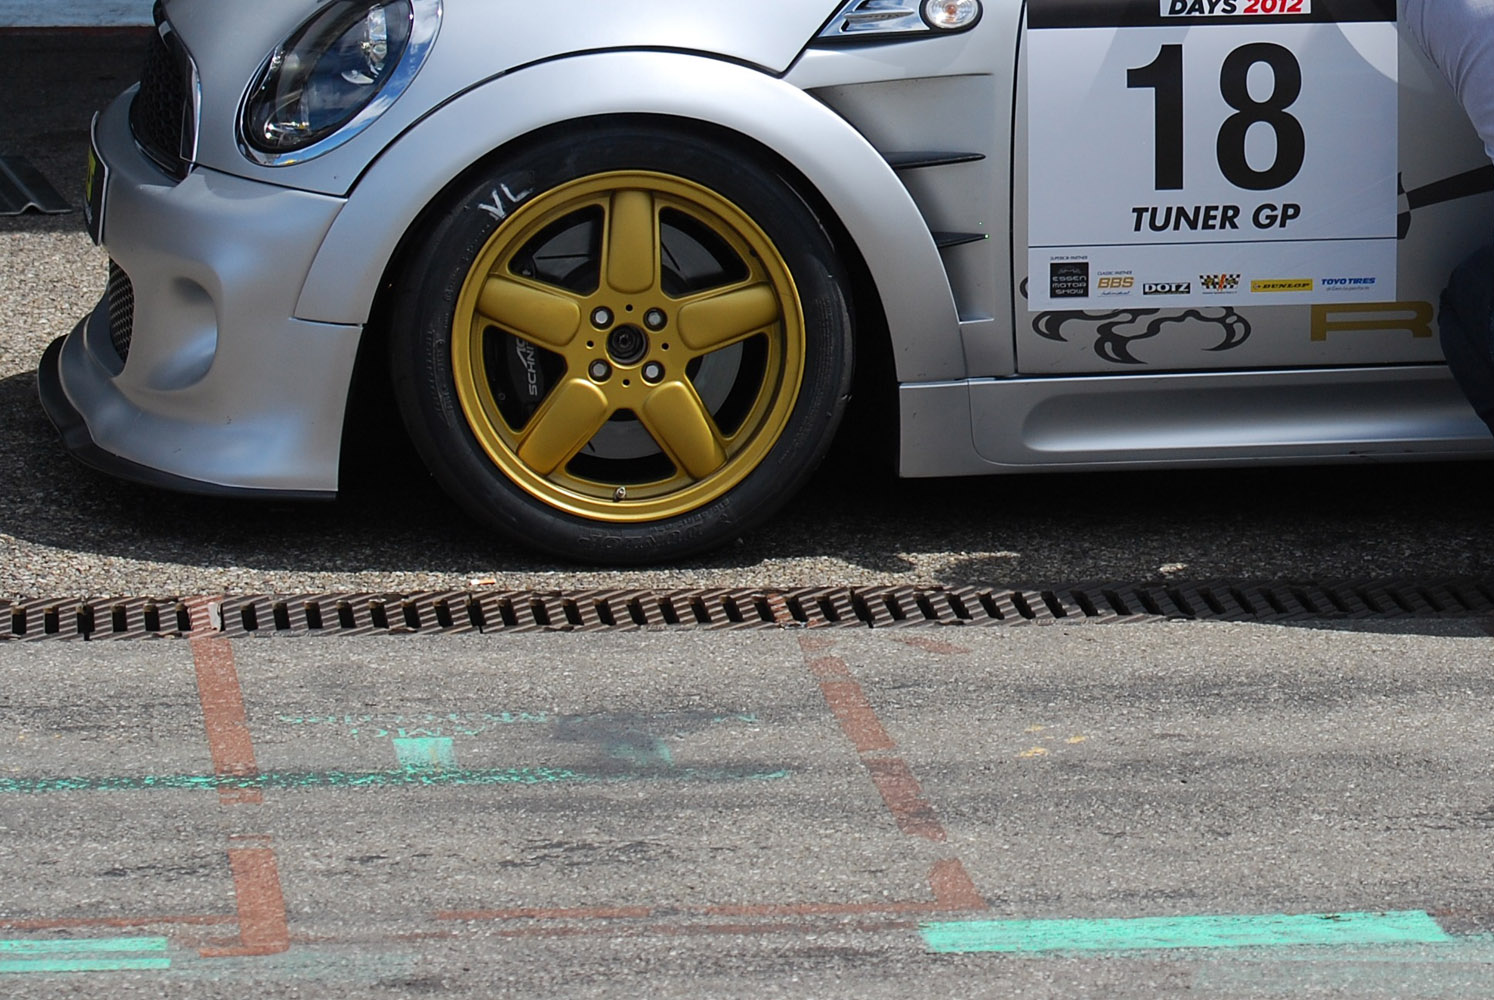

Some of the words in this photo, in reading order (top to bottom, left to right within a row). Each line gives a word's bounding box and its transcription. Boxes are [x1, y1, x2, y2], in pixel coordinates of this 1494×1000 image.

[1127, 42, 1305, 191] 18
[478, 183, 533, 219] VL
[1132, 205, 1240, 232] TUNER
[1252, 203, 1301, 229] GP
[1098, 277, 1134, 289] BBS
[1144, 282, 1189, 293] DOTZ
[1321, 278, 1346, 286] TOYO
[1348, 277, 1376, 285] TIRES
[526, 341, 538, 397] SCHNI
